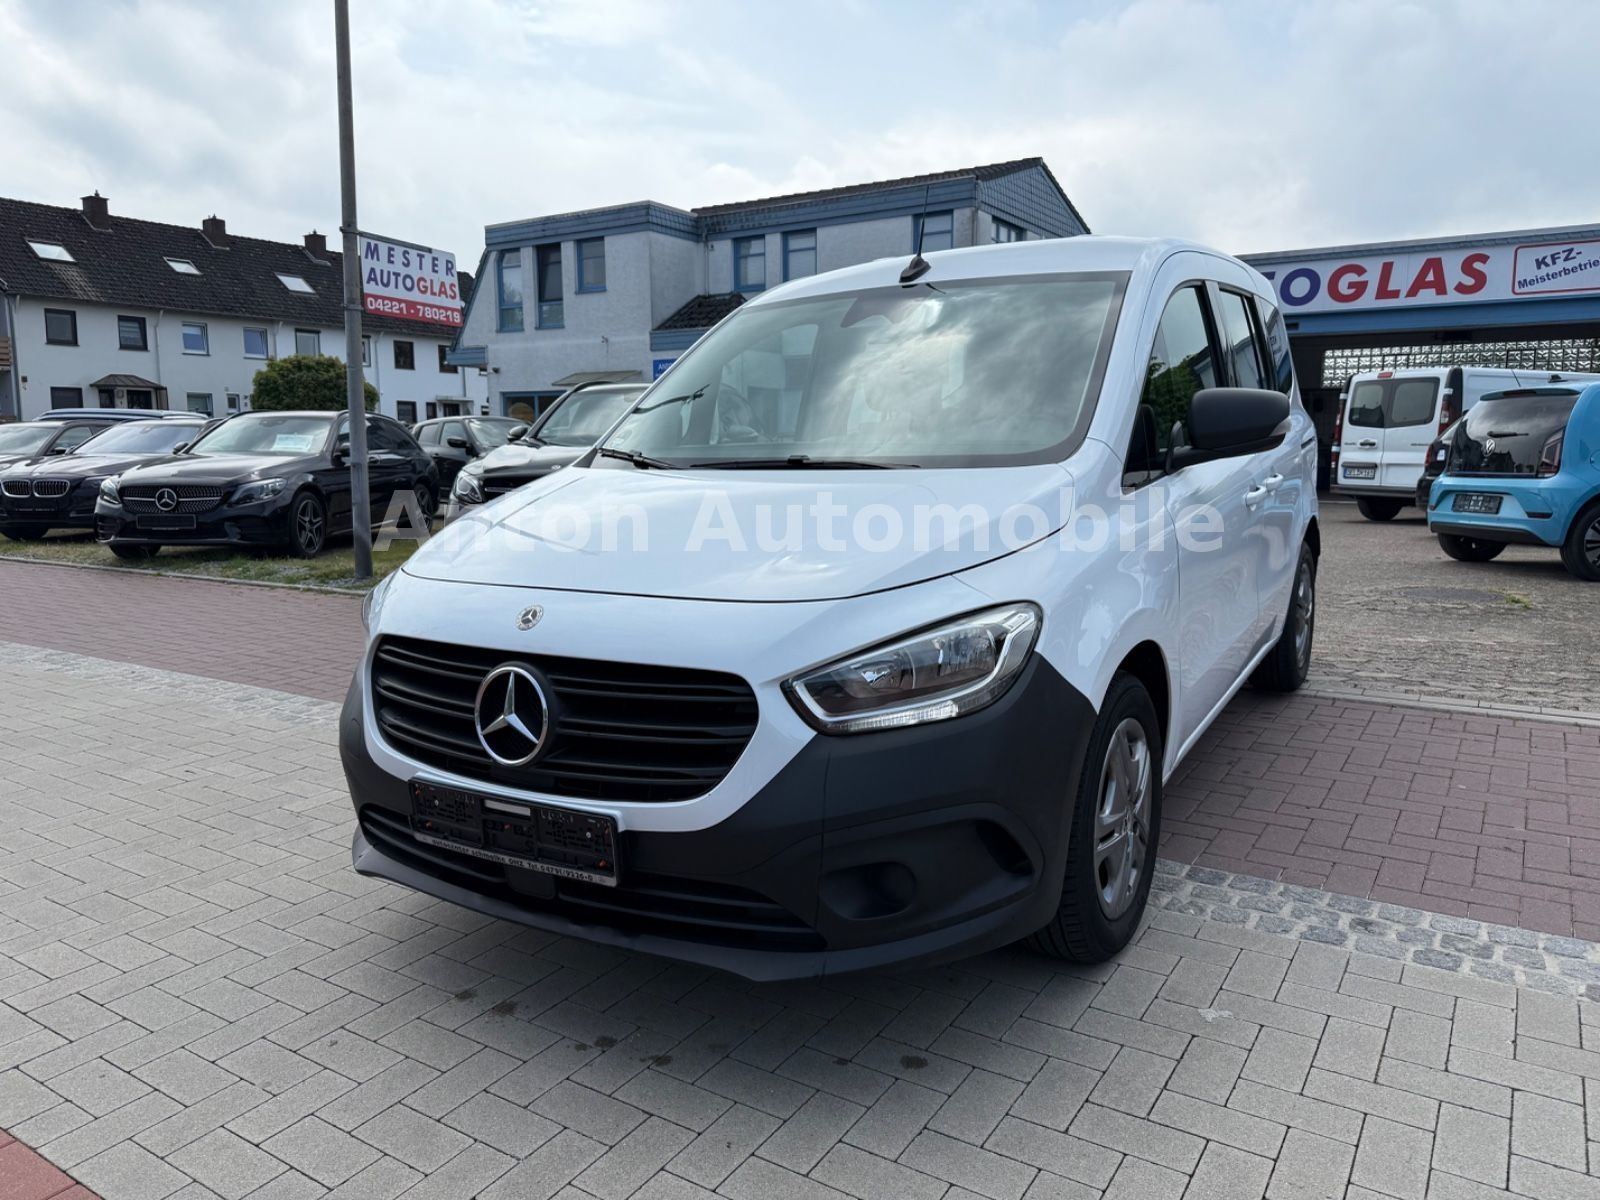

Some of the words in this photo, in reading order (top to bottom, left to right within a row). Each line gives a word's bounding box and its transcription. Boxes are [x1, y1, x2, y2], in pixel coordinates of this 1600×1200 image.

[365, 241, 455, 277] MESTER
[1517, 256, 1600, 289] Meisterbetrie
[1535, 247, 1582, 270] KFZ-
[366, 267, 457, 300] AUTOGLAS
[367, 297, 407, 315] 04221
[416, 305, 461, 323] 780219
